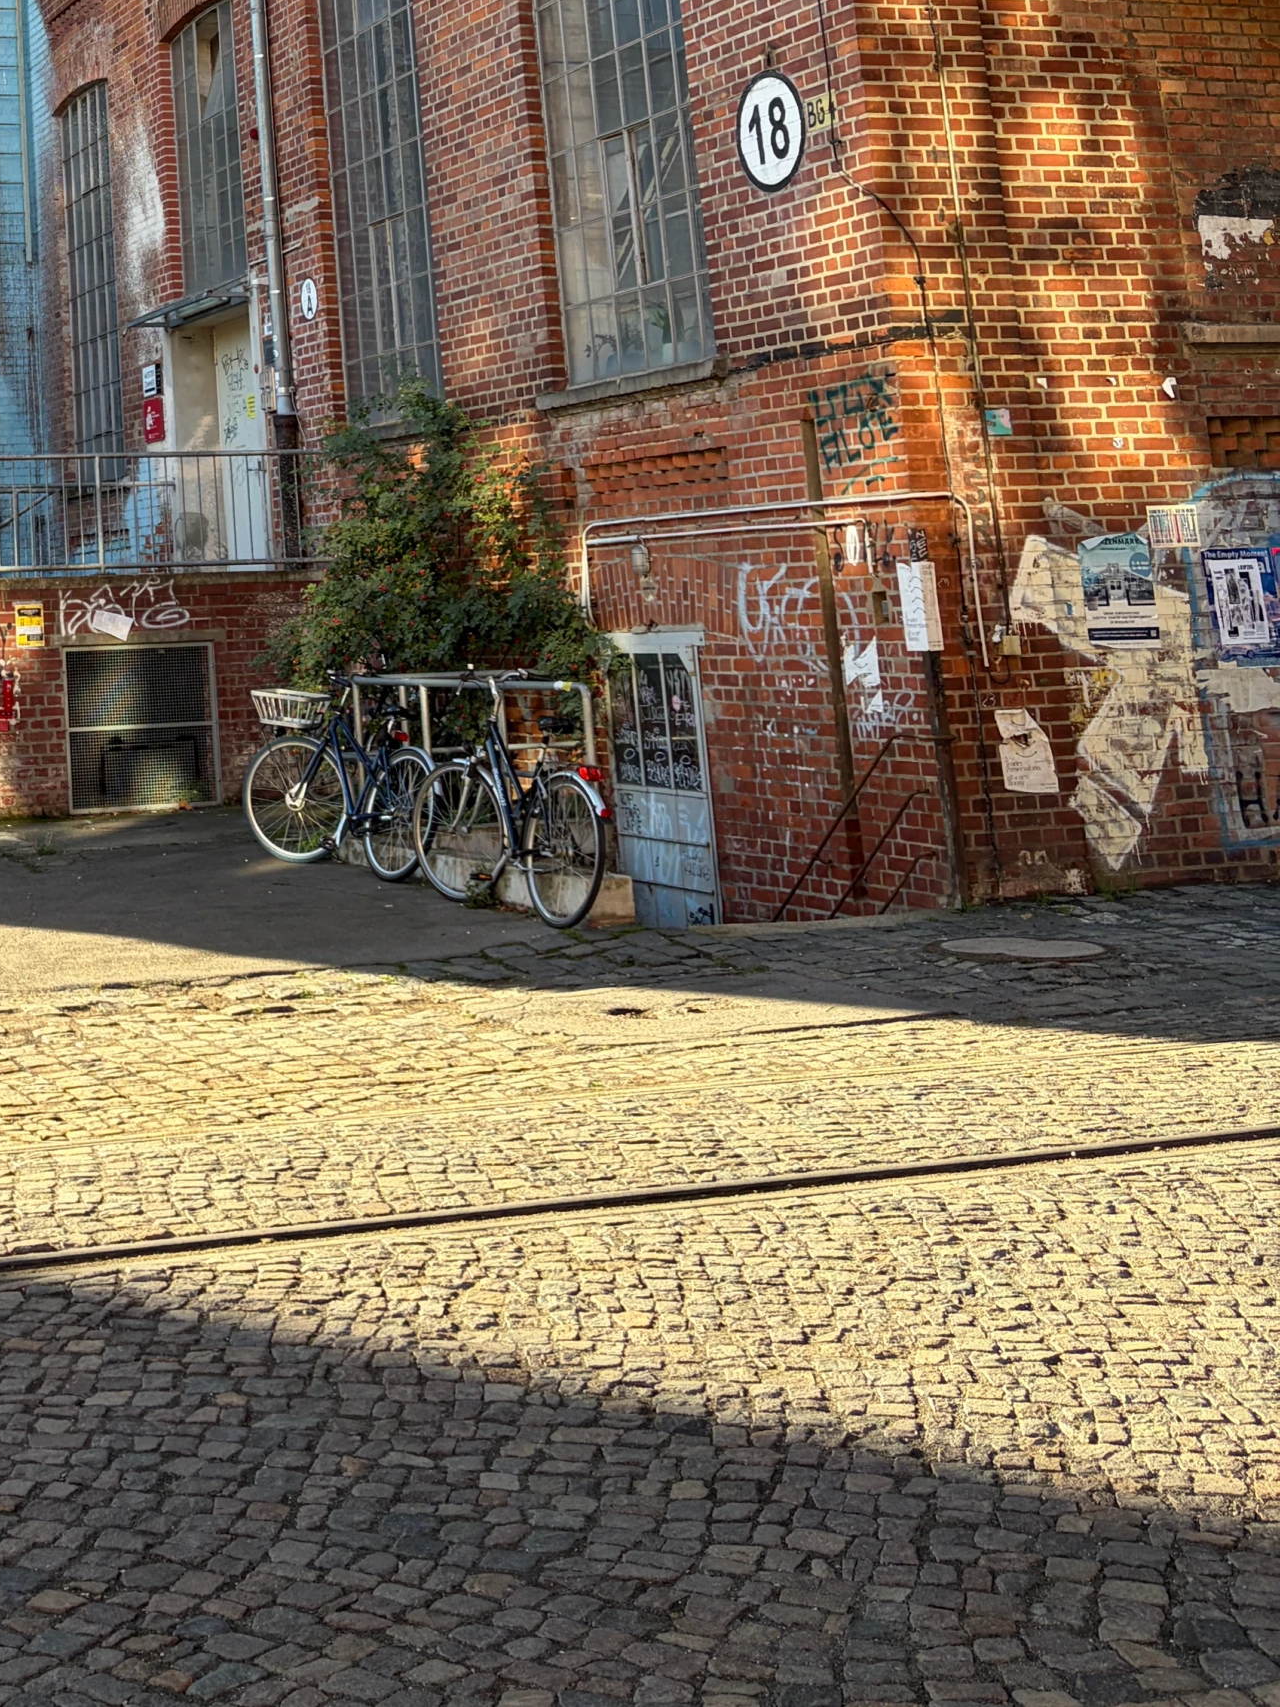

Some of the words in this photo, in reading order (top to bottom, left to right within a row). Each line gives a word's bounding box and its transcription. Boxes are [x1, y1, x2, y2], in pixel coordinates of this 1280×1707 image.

[747, 96, 791, 166] 18
[306, 295, 314, 317] A
[1204, 551, 1216, 559] The
[1216, 551, 1239, 560] Empty
